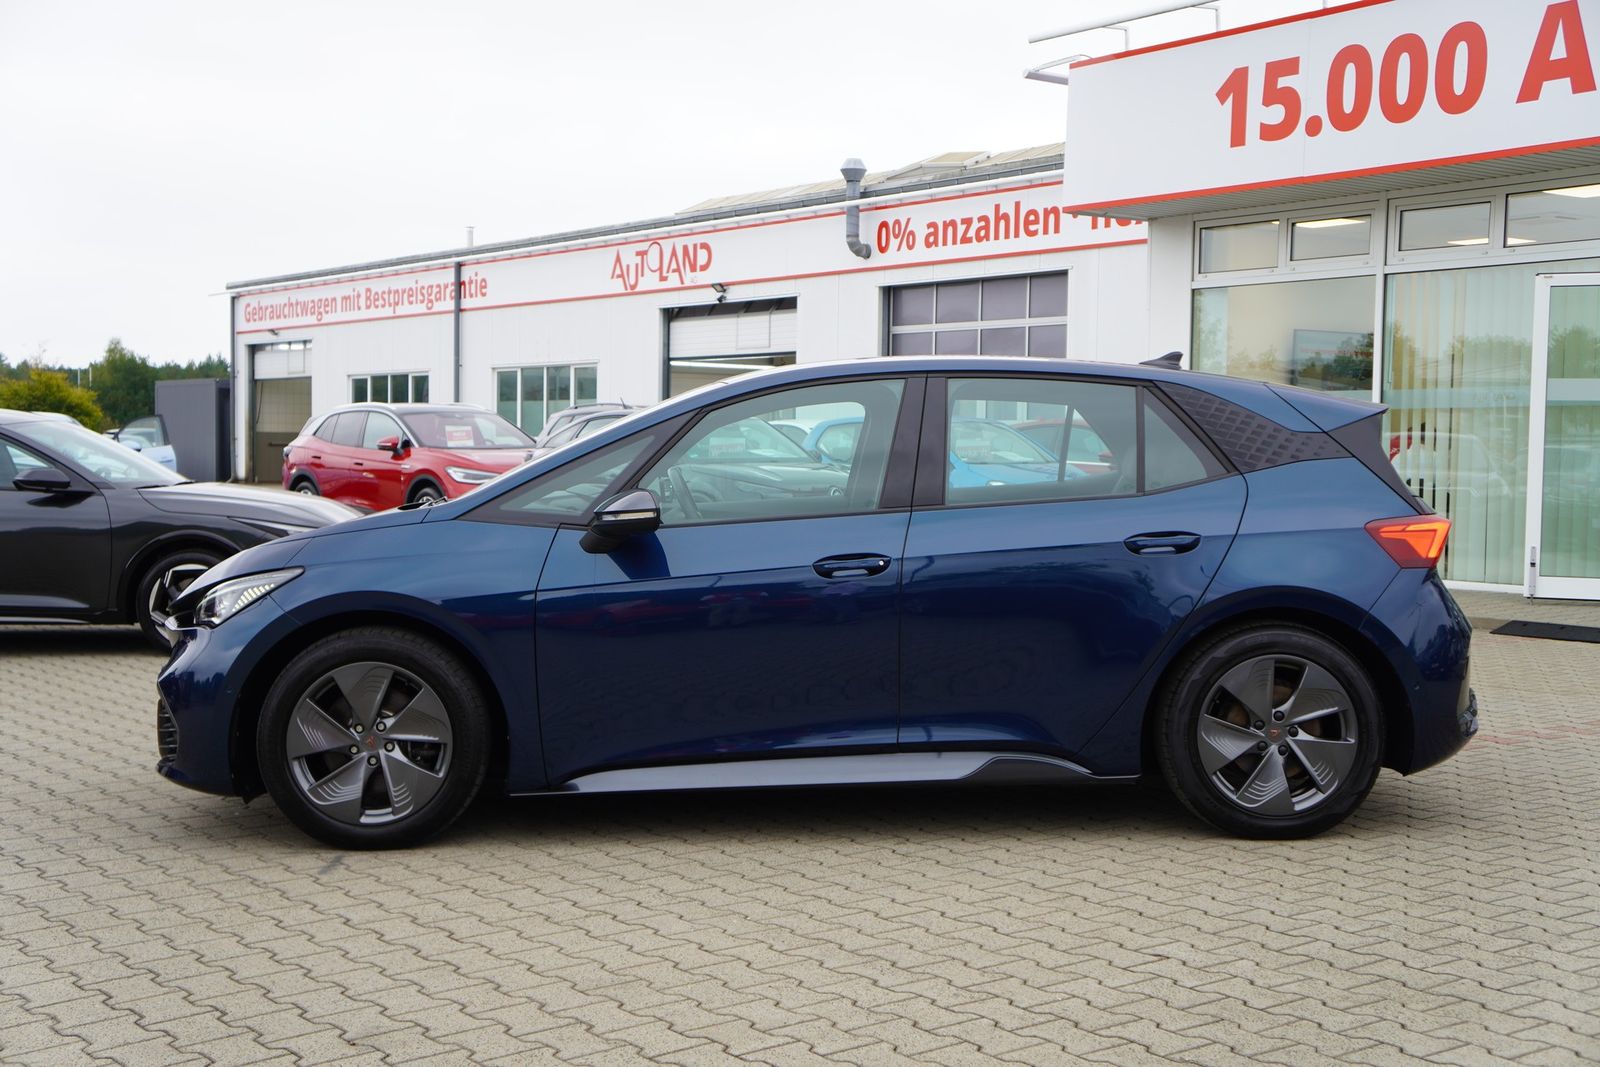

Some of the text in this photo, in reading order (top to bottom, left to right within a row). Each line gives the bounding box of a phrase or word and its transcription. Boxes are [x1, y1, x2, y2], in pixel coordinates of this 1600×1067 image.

[1215, 0, 1597, 149] 15.000 A
[876, 217, 917, 254] 0%
[924, 200, 1061, 249] anzahlen
[611, 241, 713, 291] AUTOLAND
[244, 271, 488, 323] Gebrauchtwagen mit Bestpreisgarantie
